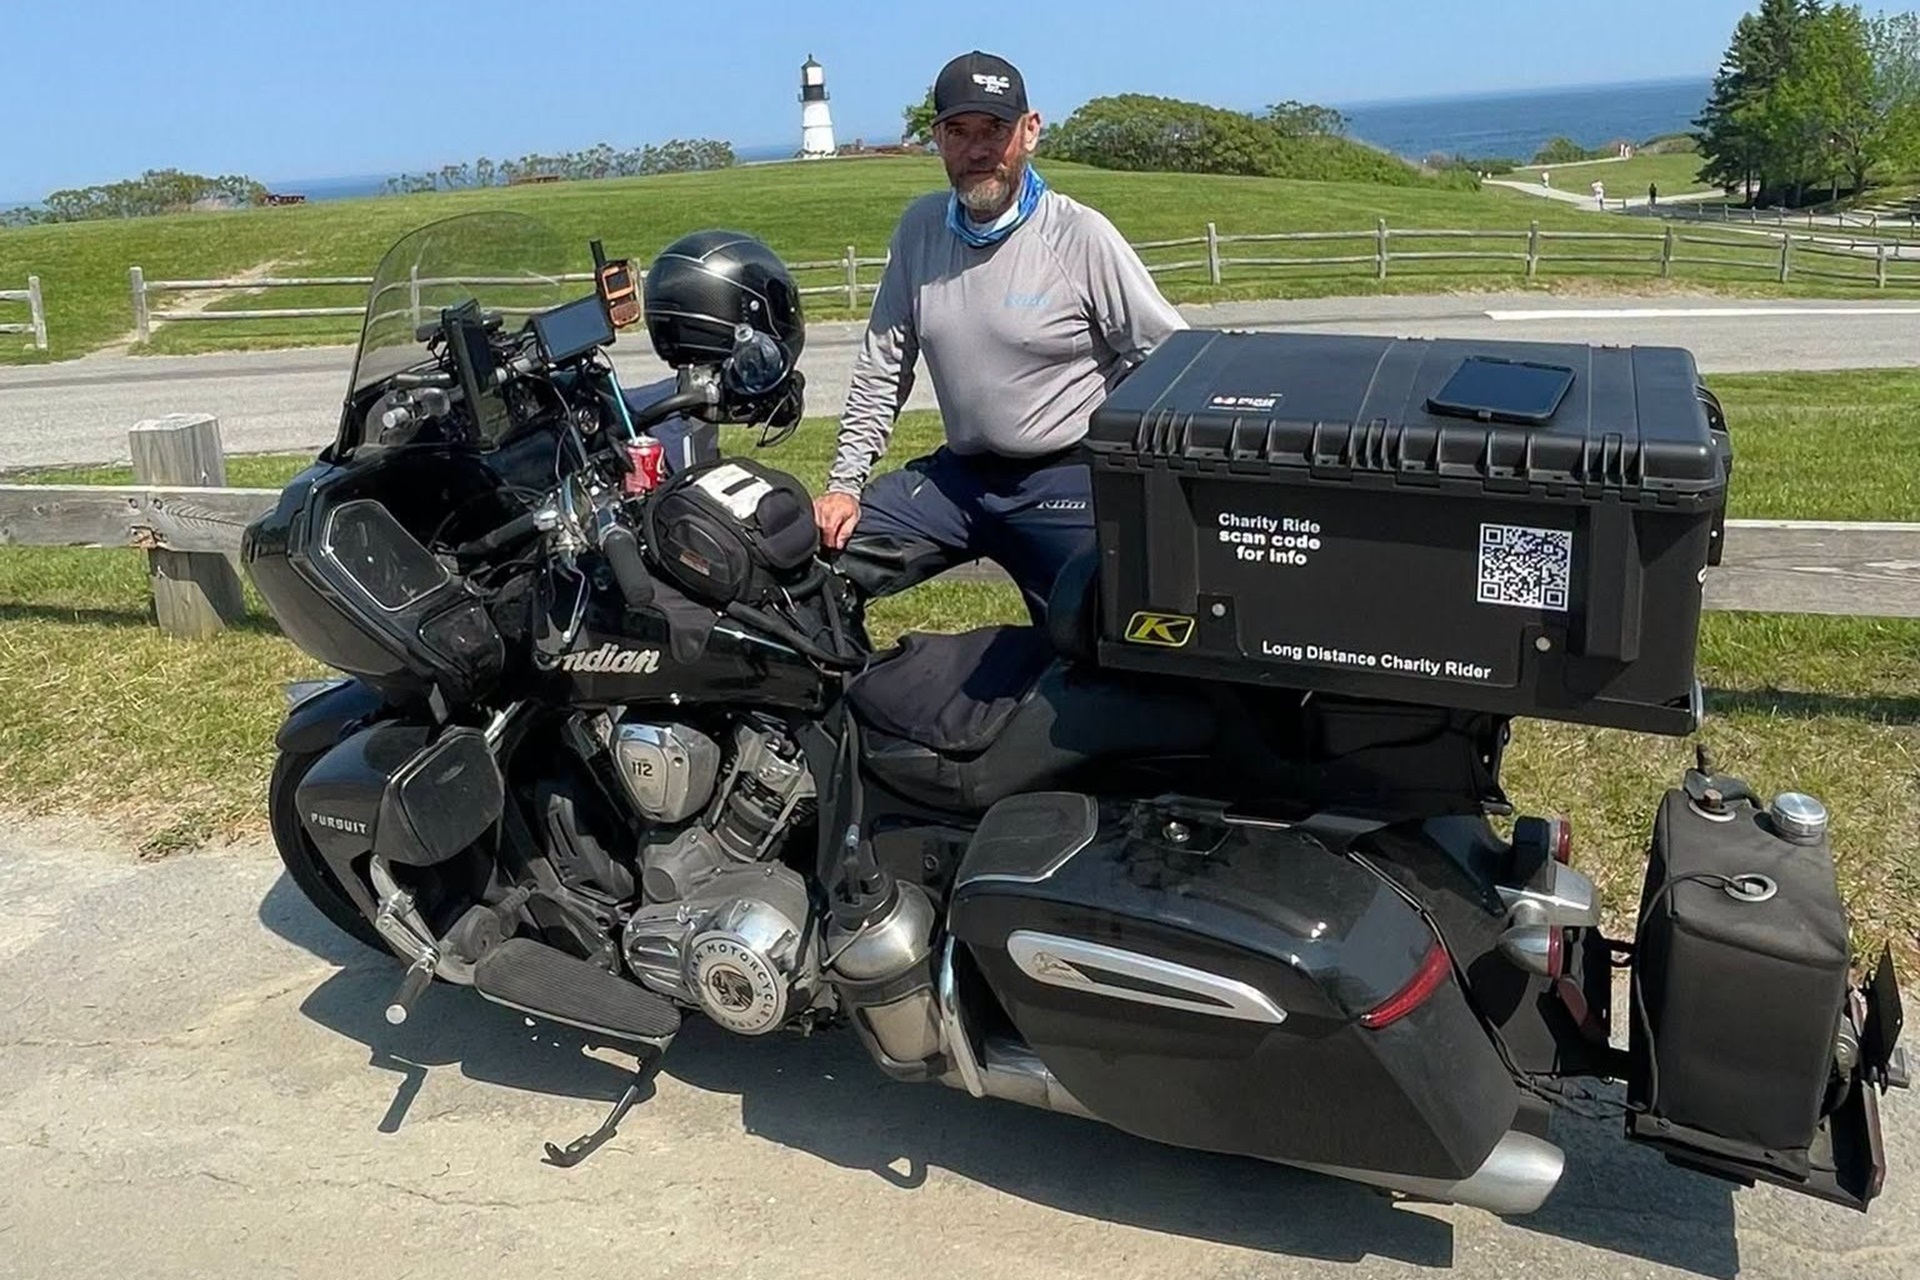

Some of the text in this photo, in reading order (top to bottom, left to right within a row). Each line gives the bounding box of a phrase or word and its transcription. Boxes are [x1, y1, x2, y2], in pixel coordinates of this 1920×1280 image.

[1218, 512, 1321, 534] Charity Ride
[1219, 530, 1321, 550] scan code
[1236, 545, 1264, 561] for
[536, 642, 661, 674] ndian
[1262, 640, 1492, 679] Long Distance Charity Rider
[631, 761, 653, 777] 112
[310, 811, 367, 834] PURSUIT
[706, 943, 774, 1018] MOTORCYCLE
